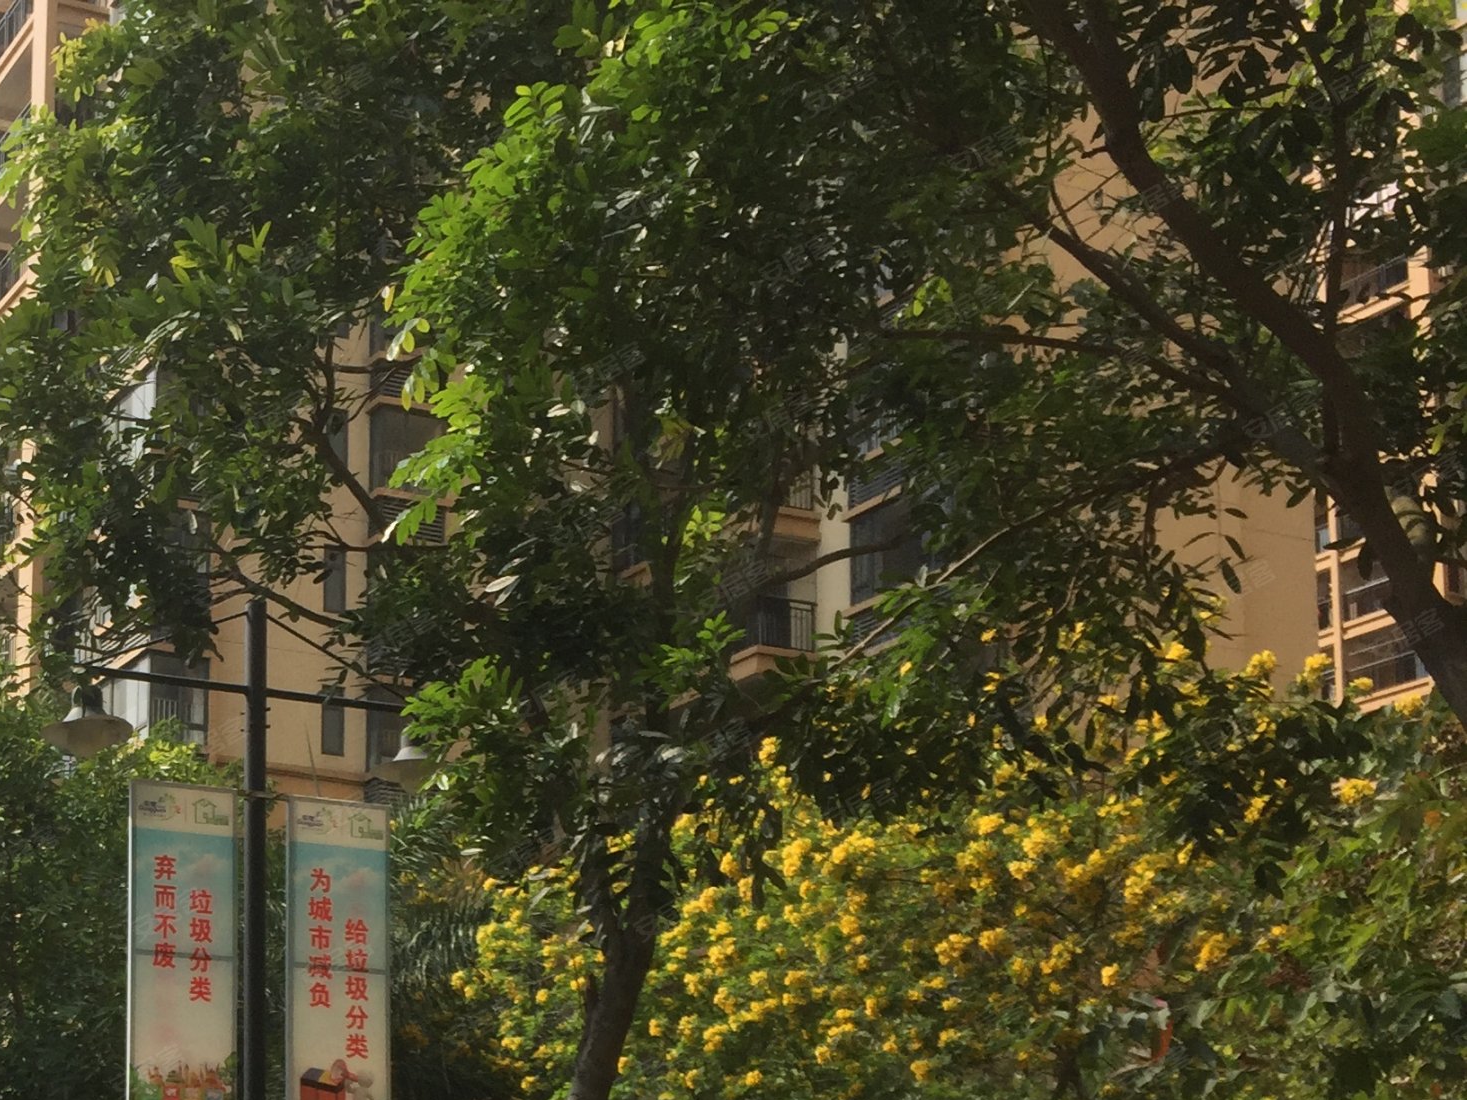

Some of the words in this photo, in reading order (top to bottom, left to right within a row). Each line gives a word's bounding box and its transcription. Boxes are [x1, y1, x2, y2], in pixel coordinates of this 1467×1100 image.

[153, 854, 177, 969] 弃而不废
[189, 889, 214, 1002] 垃圾分类
[309, 867, 333, 1009] 为城市减负
[345, 918, 369, 1059] 给垃圾分类
